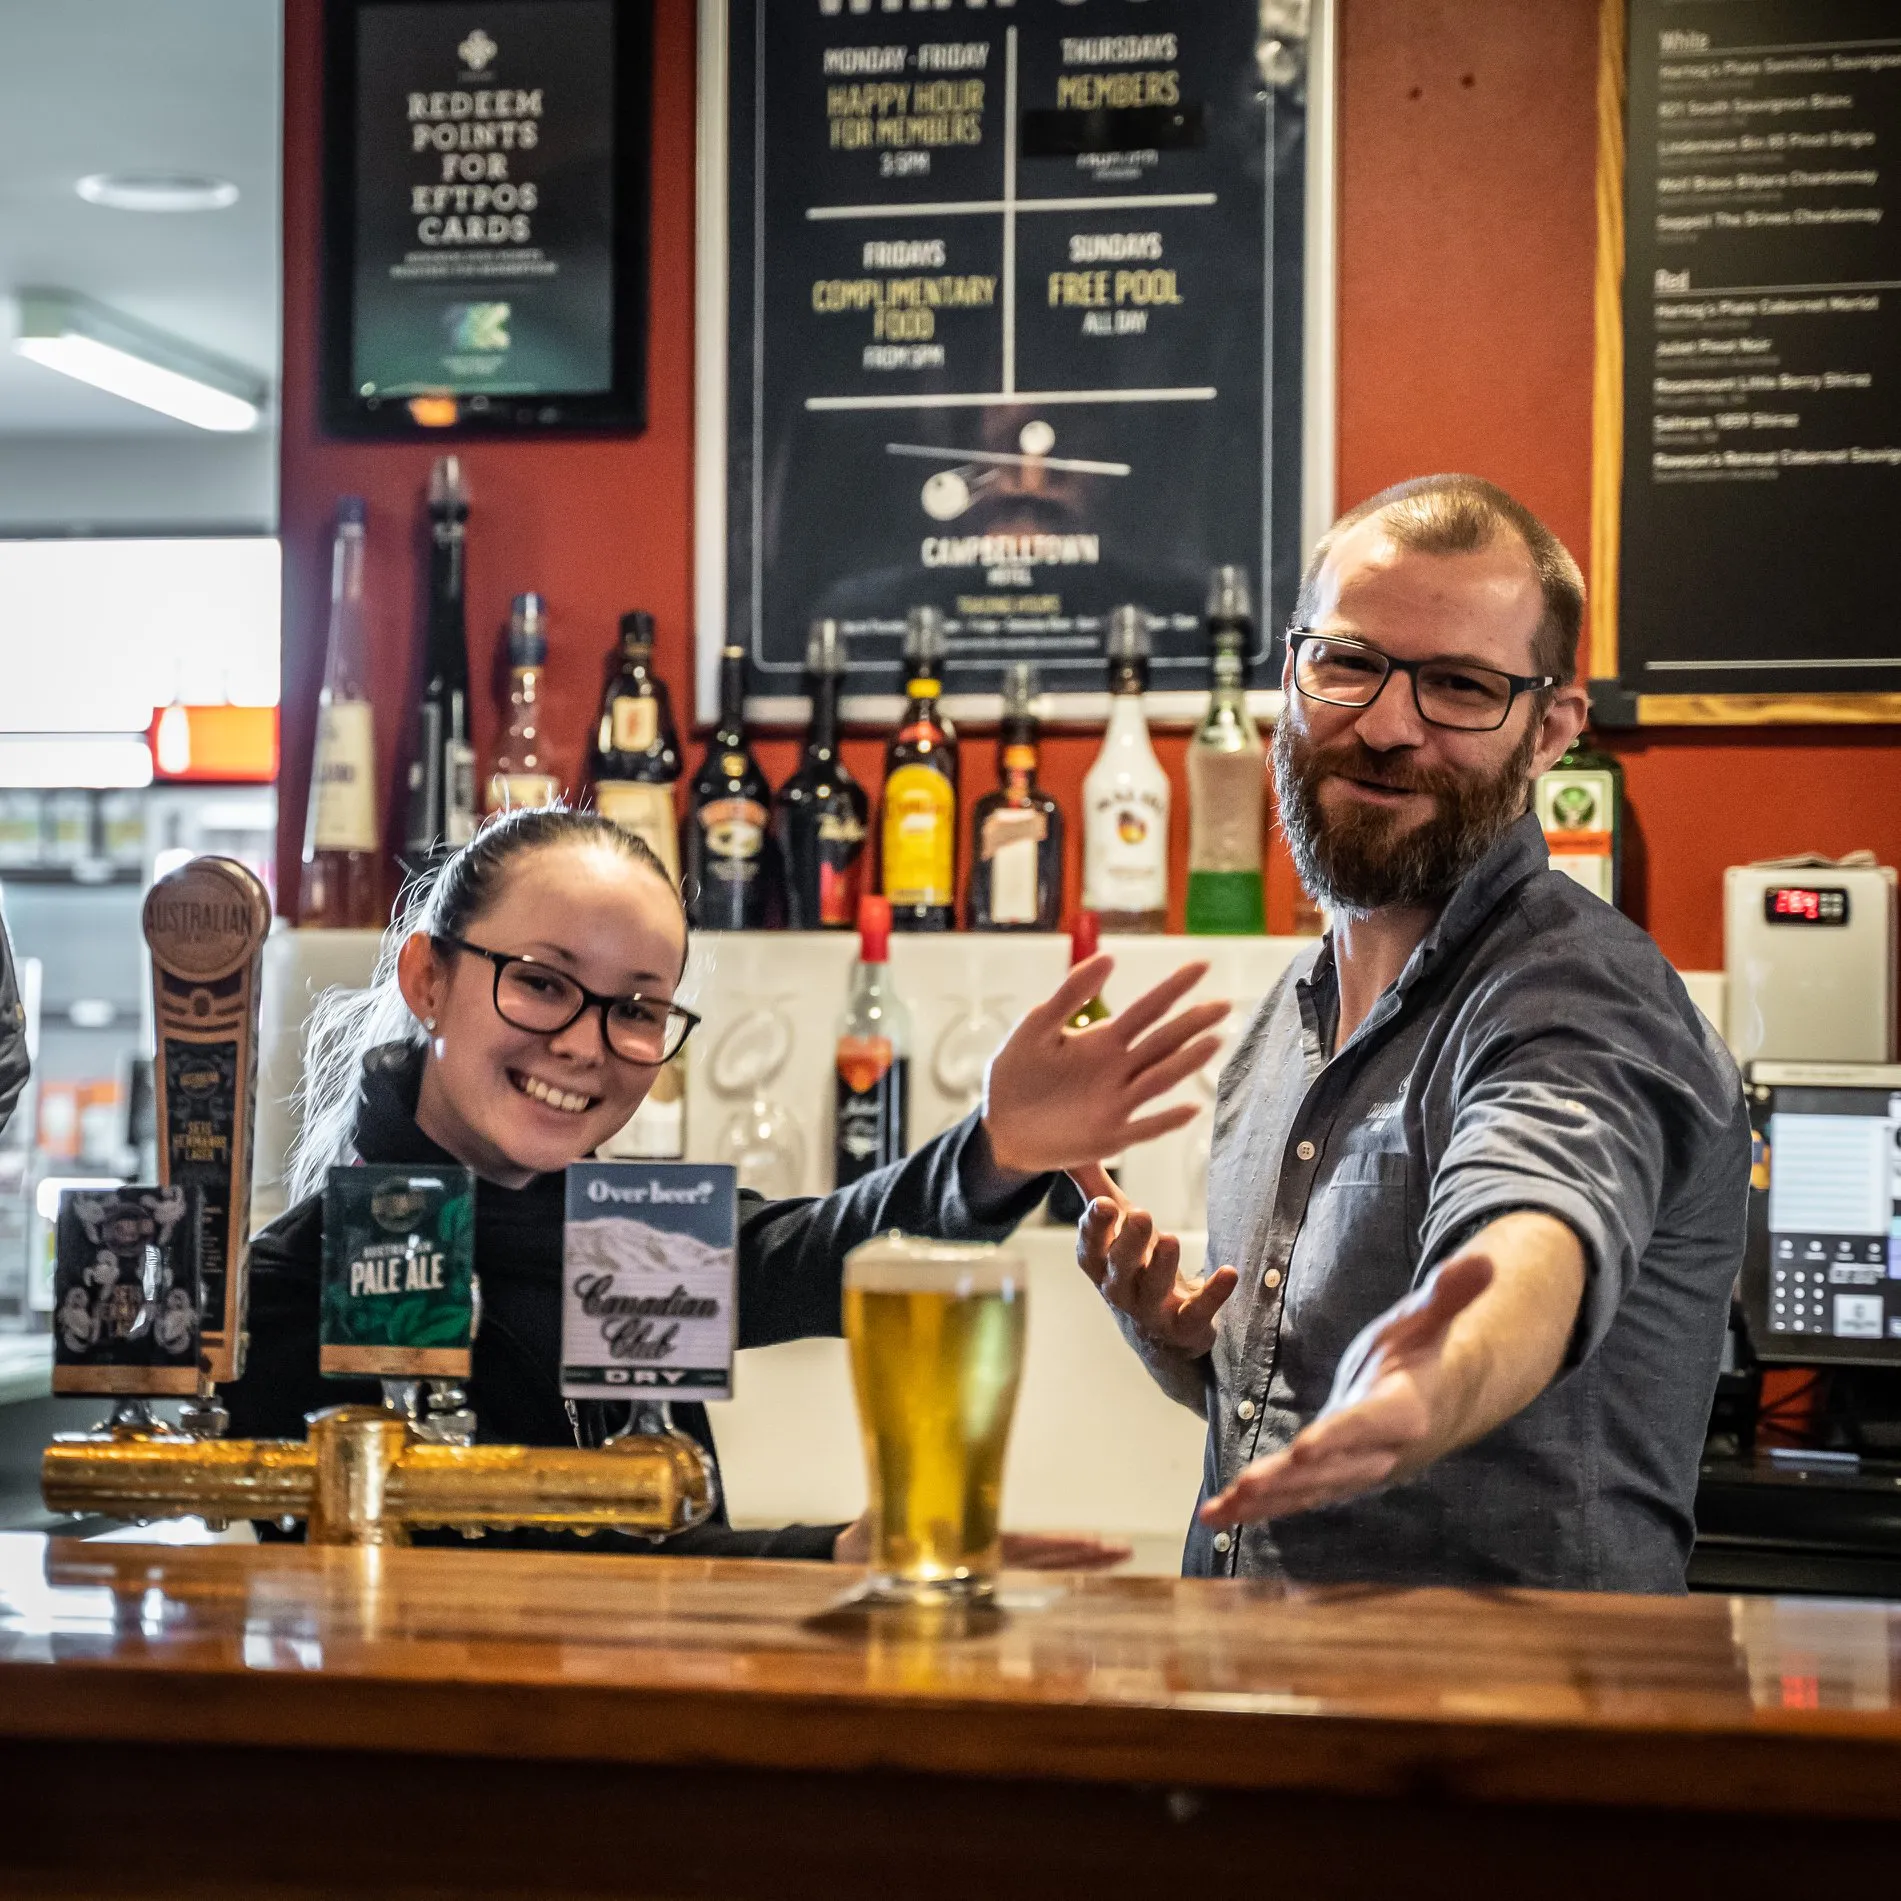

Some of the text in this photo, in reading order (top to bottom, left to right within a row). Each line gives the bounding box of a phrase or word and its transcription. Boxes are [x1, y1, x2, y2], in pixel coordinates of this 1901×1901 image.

[824, 45, 906, 75] MONDAY
[918, 41, 989, 71] FRIDAY
[1061, 33, 1178, 65] THURSDAYS
[407, 89, 544, 120] REDEEM
[827, 79, 986, 117] HAPPY HOUR
[1057, 70, 1180, 110] MEMBERS
[412, 121, 539, 151] POINTS
[830, 113, 982, 149] FOR MEMBERS
[442, 153, 509, 182] FOR
[411, 183, 538, 214] EFTPOS
[417, 214, 531, 245] CARDS
[862, 239, 946, 268] FRIDAYS
[1069, 231, 1162, 263] SUNDAYS
[811, 275, 997, 313] COMPLIMENTARY
[1048, 268, 1184, 308] FREE POOL
[873, 307, 935, 341] FOOD
[1082, 309, 1149, 336] ALL DAY
[921, 534, 1100, 568] CAMPBELLTOWN
[146, 901, 253, 936] AUSTRALIAN
[587, 1177, 714, 1206] Over beer?
[350, 1253, 445, 1297] PALE ALE
[574, 1273, 720, 1319] Canadian
[600, 1319, 681, 1360] Club
[603, 1369, 688, 1385] DRY
